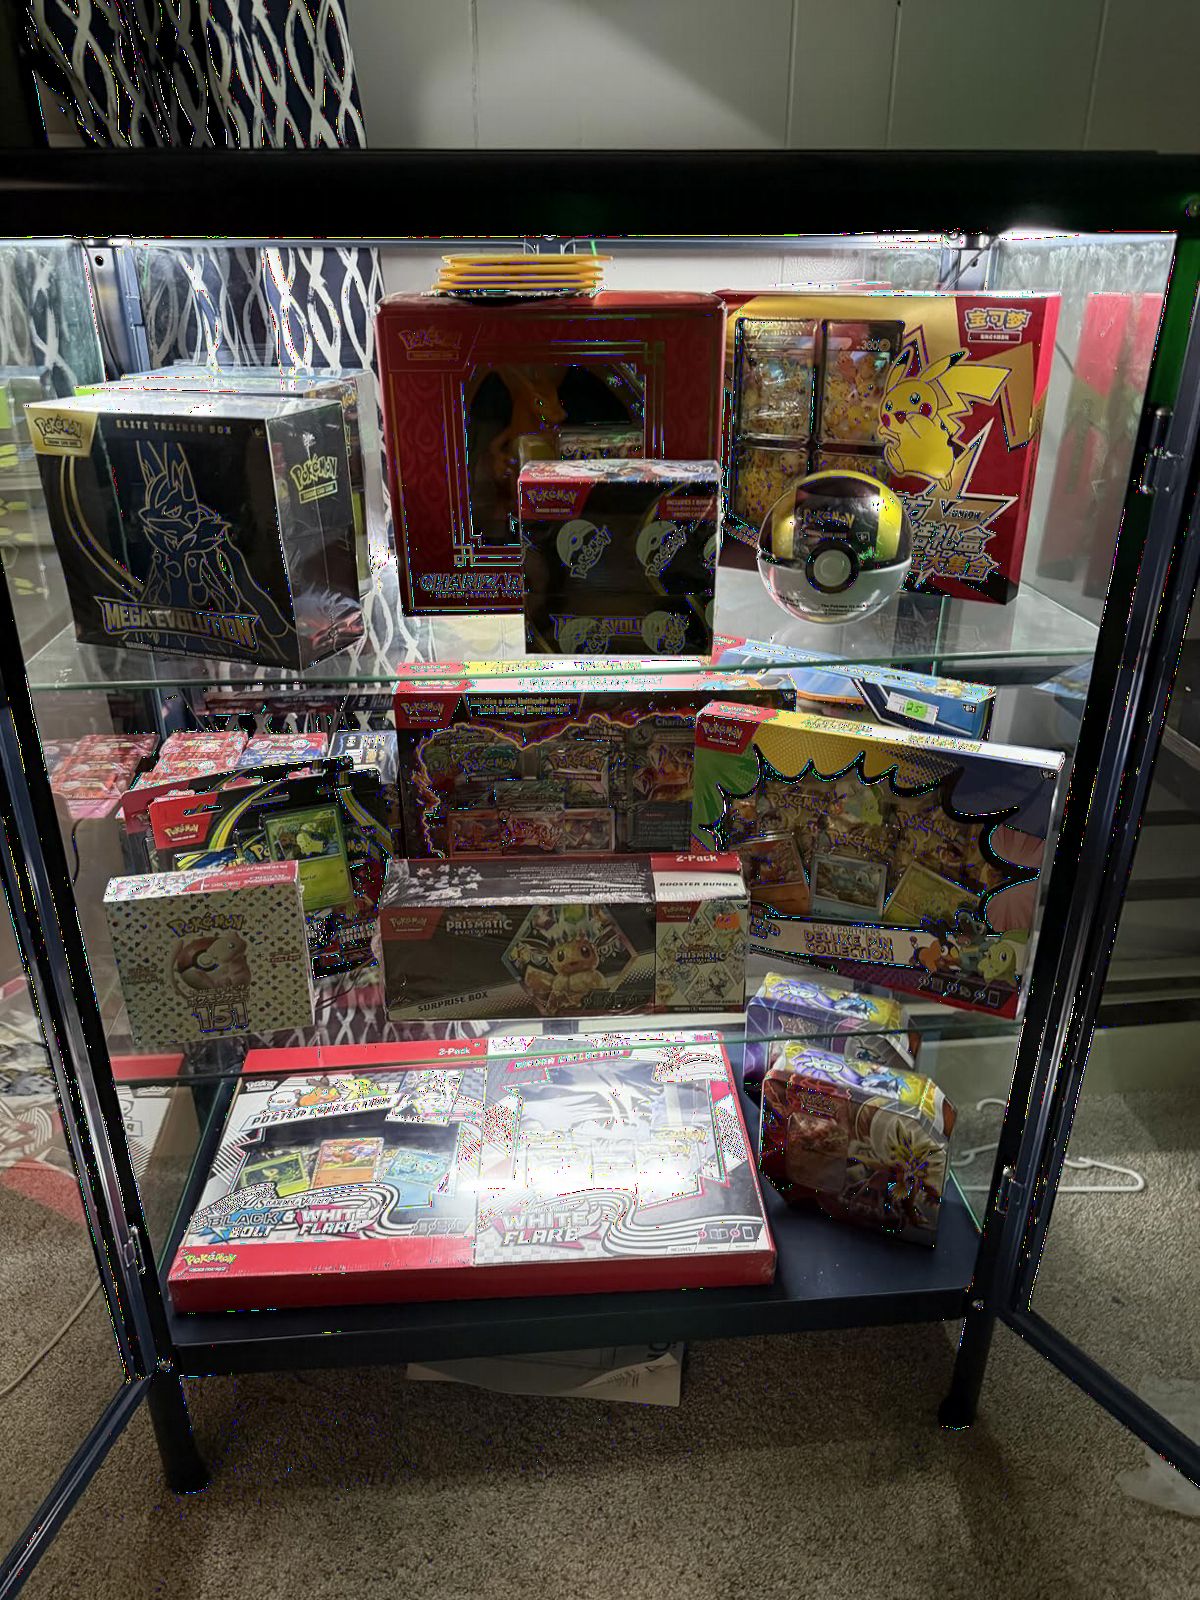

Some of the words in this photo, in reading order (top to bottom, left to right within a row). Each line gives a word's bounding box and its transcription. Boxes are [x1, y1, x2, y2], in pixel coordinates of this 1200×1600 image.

[965, 307, 1031, 331] 宝可梦
[116, 420, 148, 430] ELITE
[290, 454, 338, 490] Pokémon
[526, 487, 578, 505] Pokémon
[420, 572, 524, 591] CHARIZAR
[103, 602, 153, 631] MEGA
[155, 609, 256, 648] EVOLUTION
[400, 701, 445, 717] Pokémon
[906, 702, 923, 713] 25
[702, 721, 743, 740] Pokémon
[676, 854, 718, 862] 2-Pack
[167, 913, 244, 937] Pokémon
[446, 918, 513, 932] PRISMATIC
[804, 929, 861, 947] DELUXE
[806, 942, 895, 961] COLLECTION
[418, 997, 465, 1012] SURPRISE
[468, 991, 488, 1002] BOX
[191, 1001, 249, 1032] 151
[438, 1047, 471, 1056] 2-Pack
[252, 1109, 306, 1126] POSTER
[307, 1096, 393, 1117] COLLECTION
[208, 1212, 280, 1227] BLACK
[301, 1208, 369, 1222] WHITE
[502, 1211, 590, 1231] WHITE
[229, 1225, 273, 1239] BOLT
[299, 1221, 360, 1235] FLARE
[501, 1228, 580, 1247] FLARE
[182, 1251, 237, 1265] Pokémon
